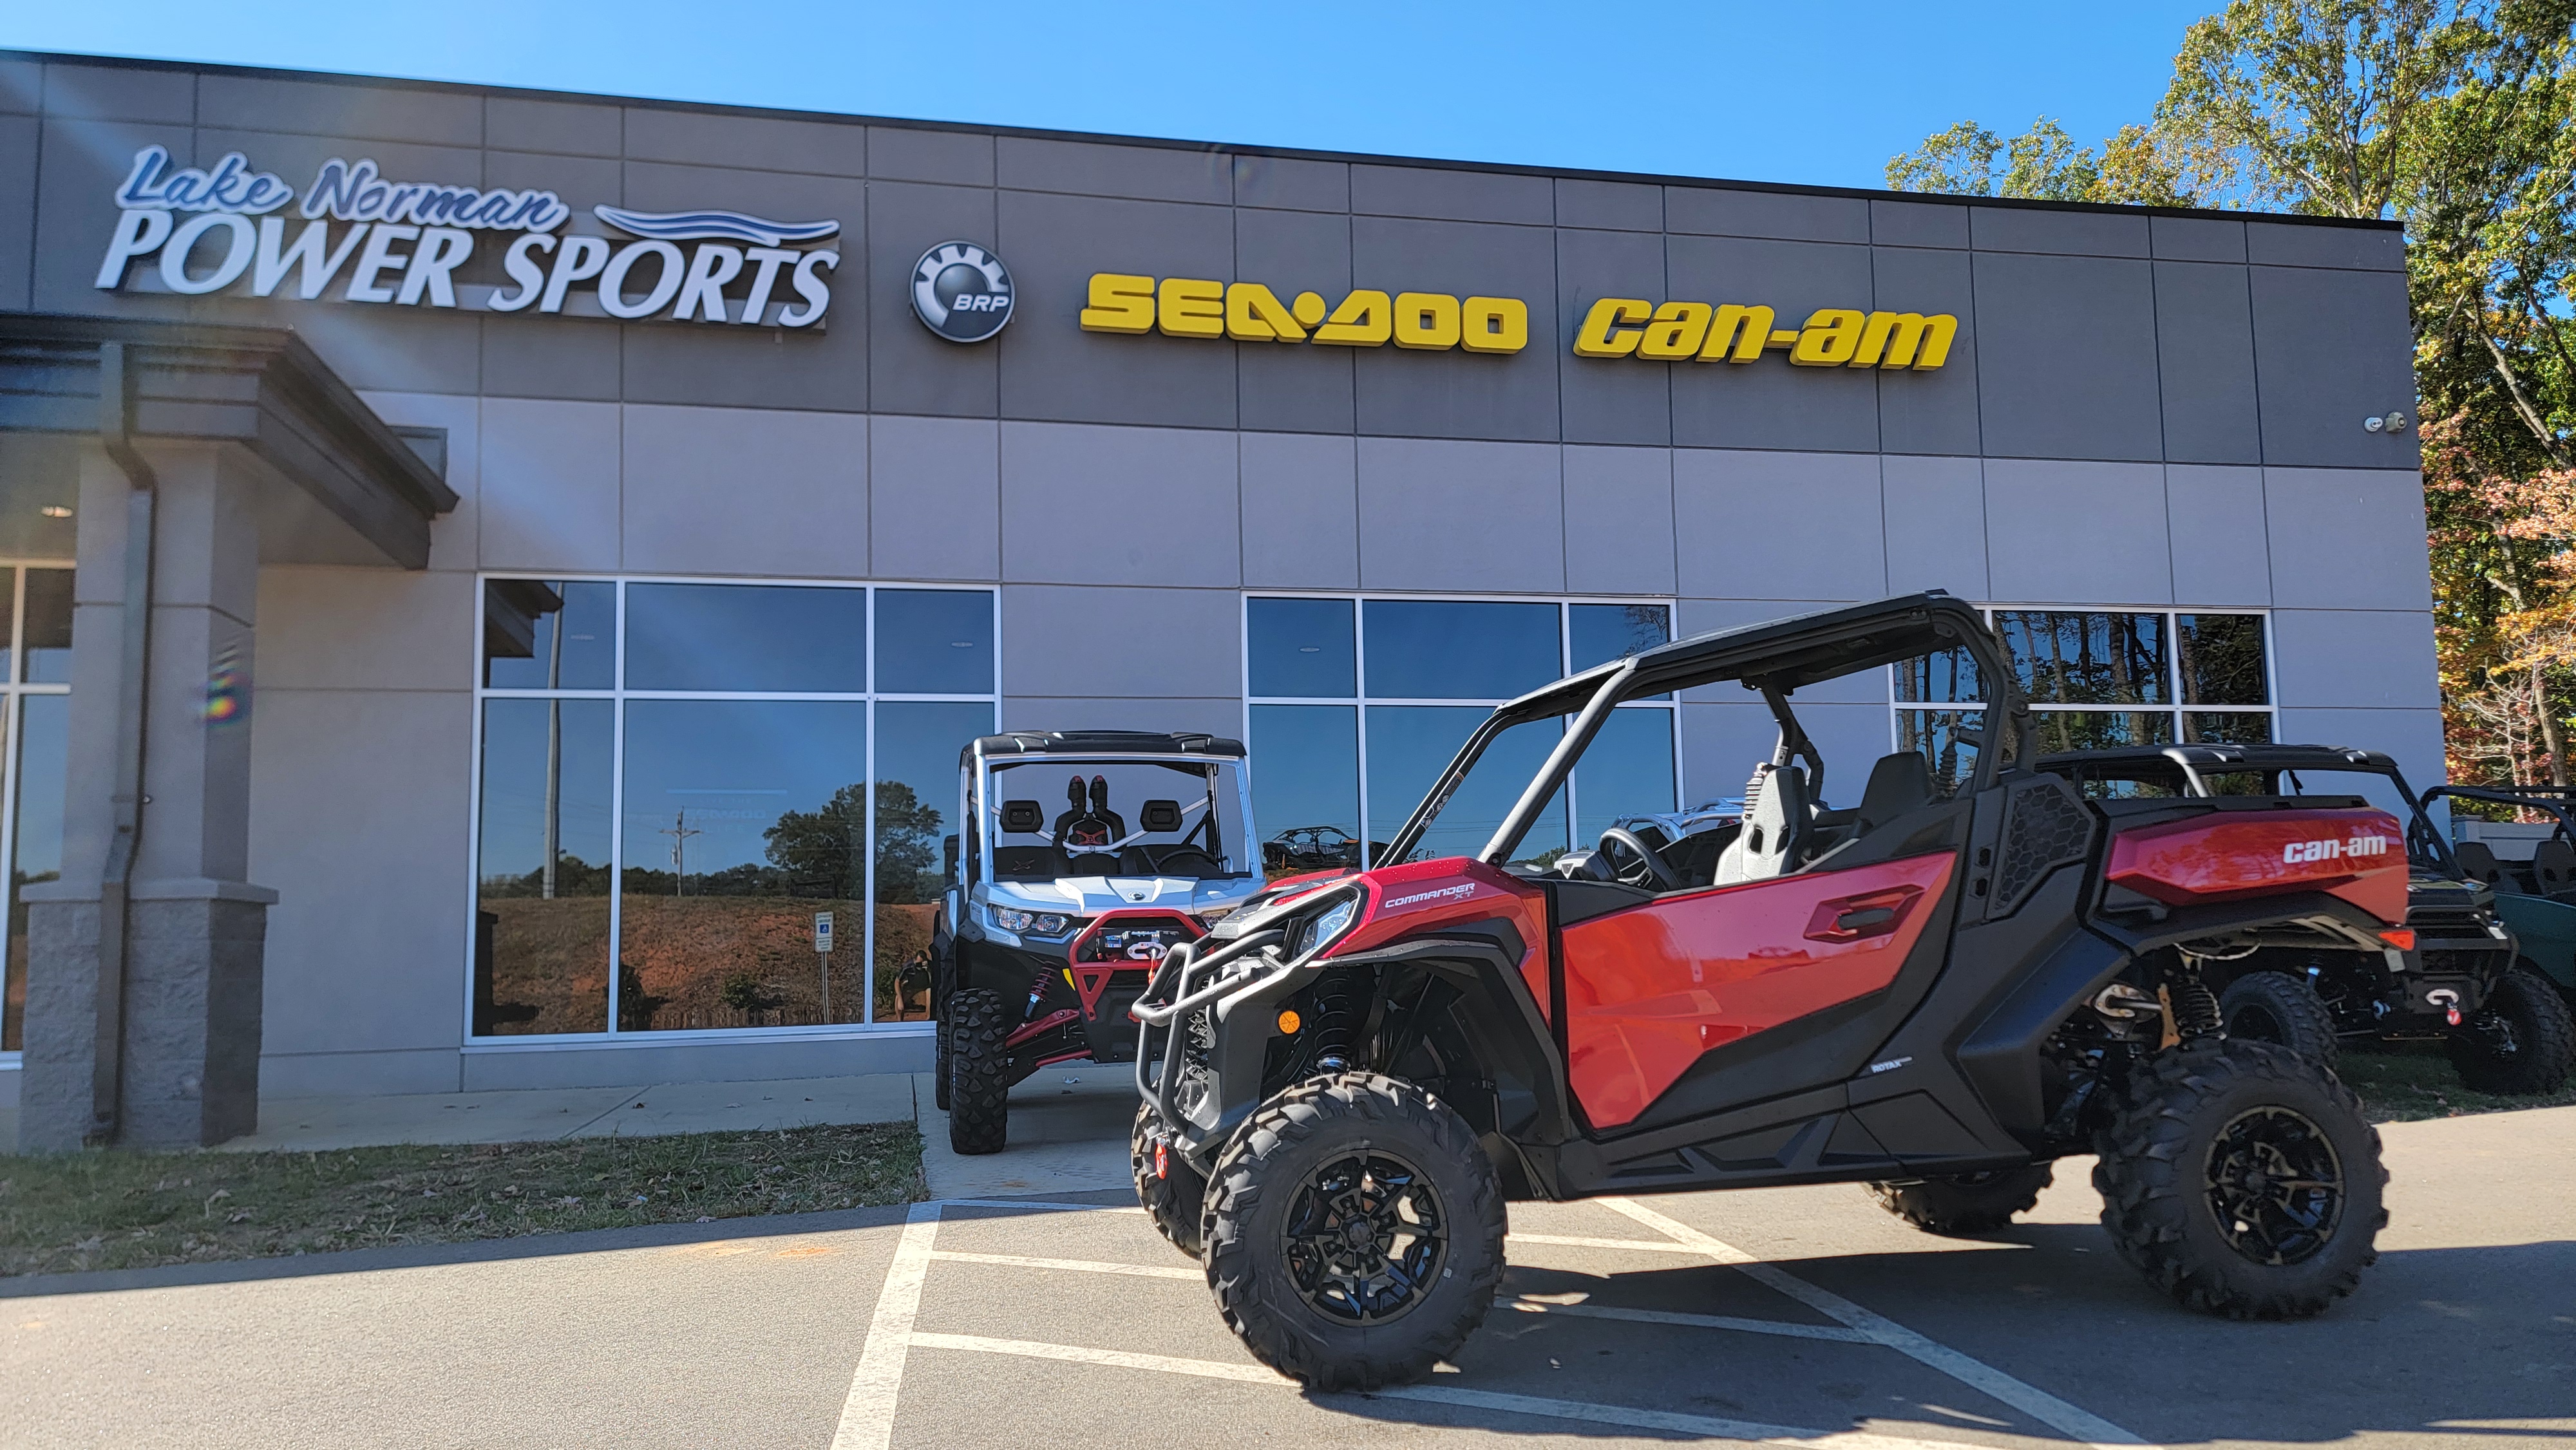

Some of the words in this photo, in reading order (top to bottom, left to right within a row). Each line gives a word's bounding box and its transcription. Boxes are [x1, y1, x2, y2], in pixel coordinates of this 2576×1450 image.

[115, 144, 294, 214] Lake
[299, 157, 569, 233] Norman
[95, 209, 473, 307] POWER
[487, 234, 840, 328] SPORTS
[952, 294, 1010, 312] BRP
[1574, 299, 1958, 369] can-am
[2283, 835, 2387, 864] can-am
[1385, 882, 1475, 909] COMMANDER
[1453, 890, 1474, 900] XT
[1870, 1060, 1902, 1074] ROTAX
